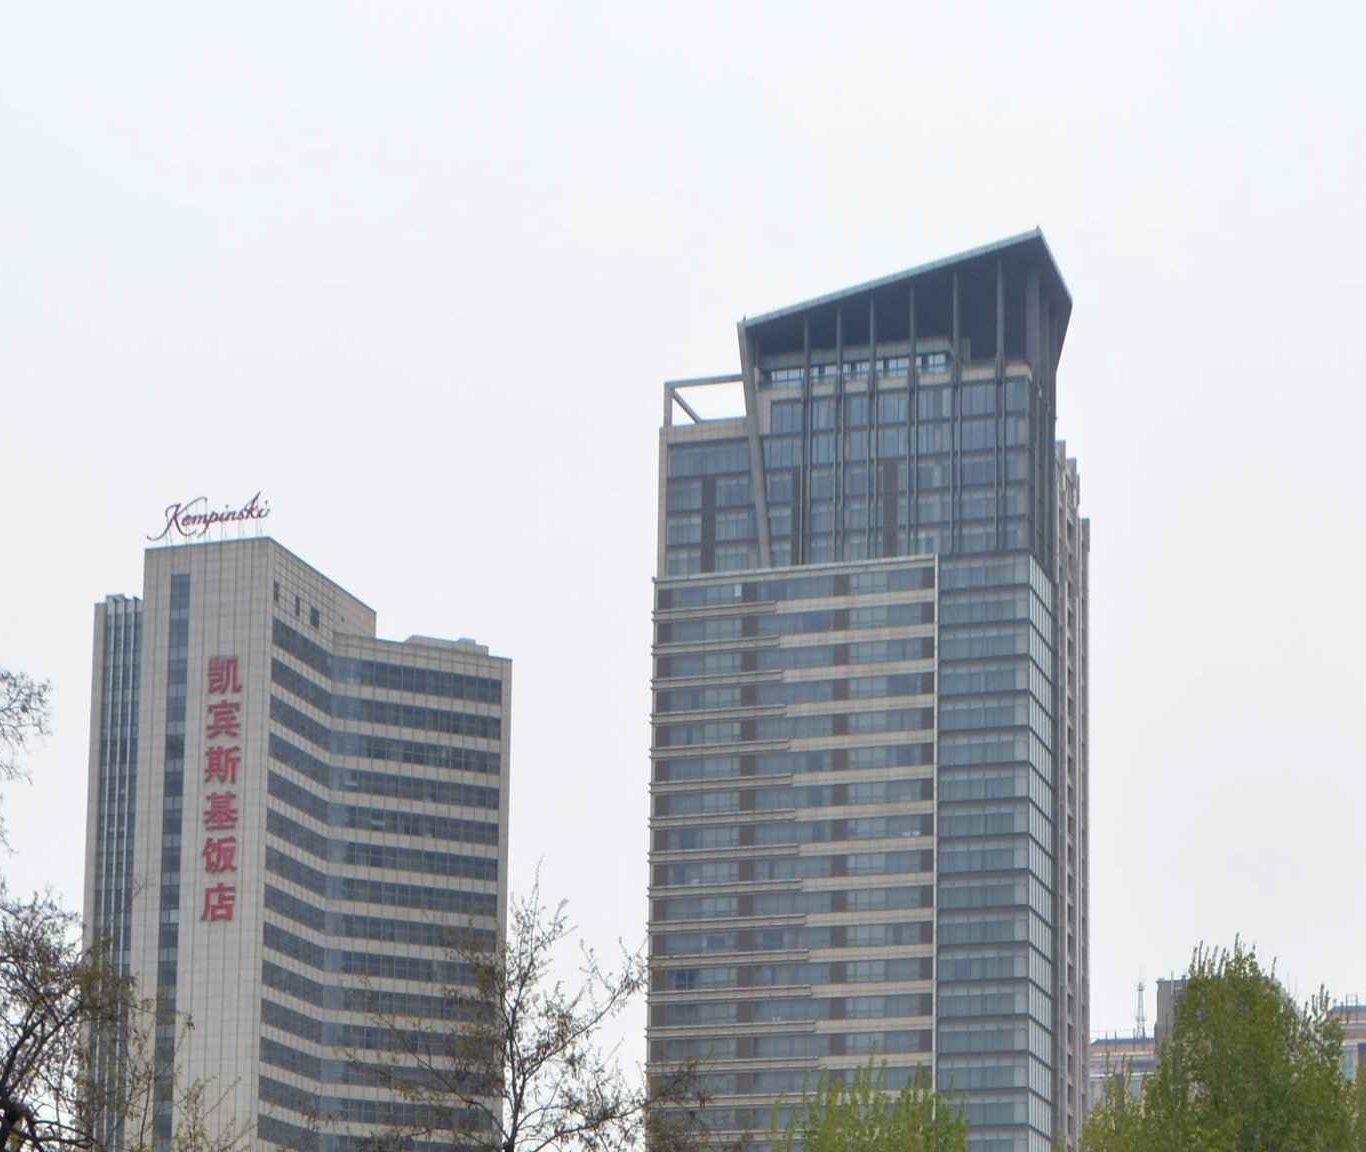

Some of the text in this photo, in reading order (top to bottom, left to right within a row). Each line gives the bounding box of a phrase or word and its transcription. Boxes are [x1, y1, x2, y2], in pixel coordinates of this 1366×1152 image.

[146, 490, 271, 541] Kempinski
[200, 655, 243, 922] 凯宾斯基饭店
